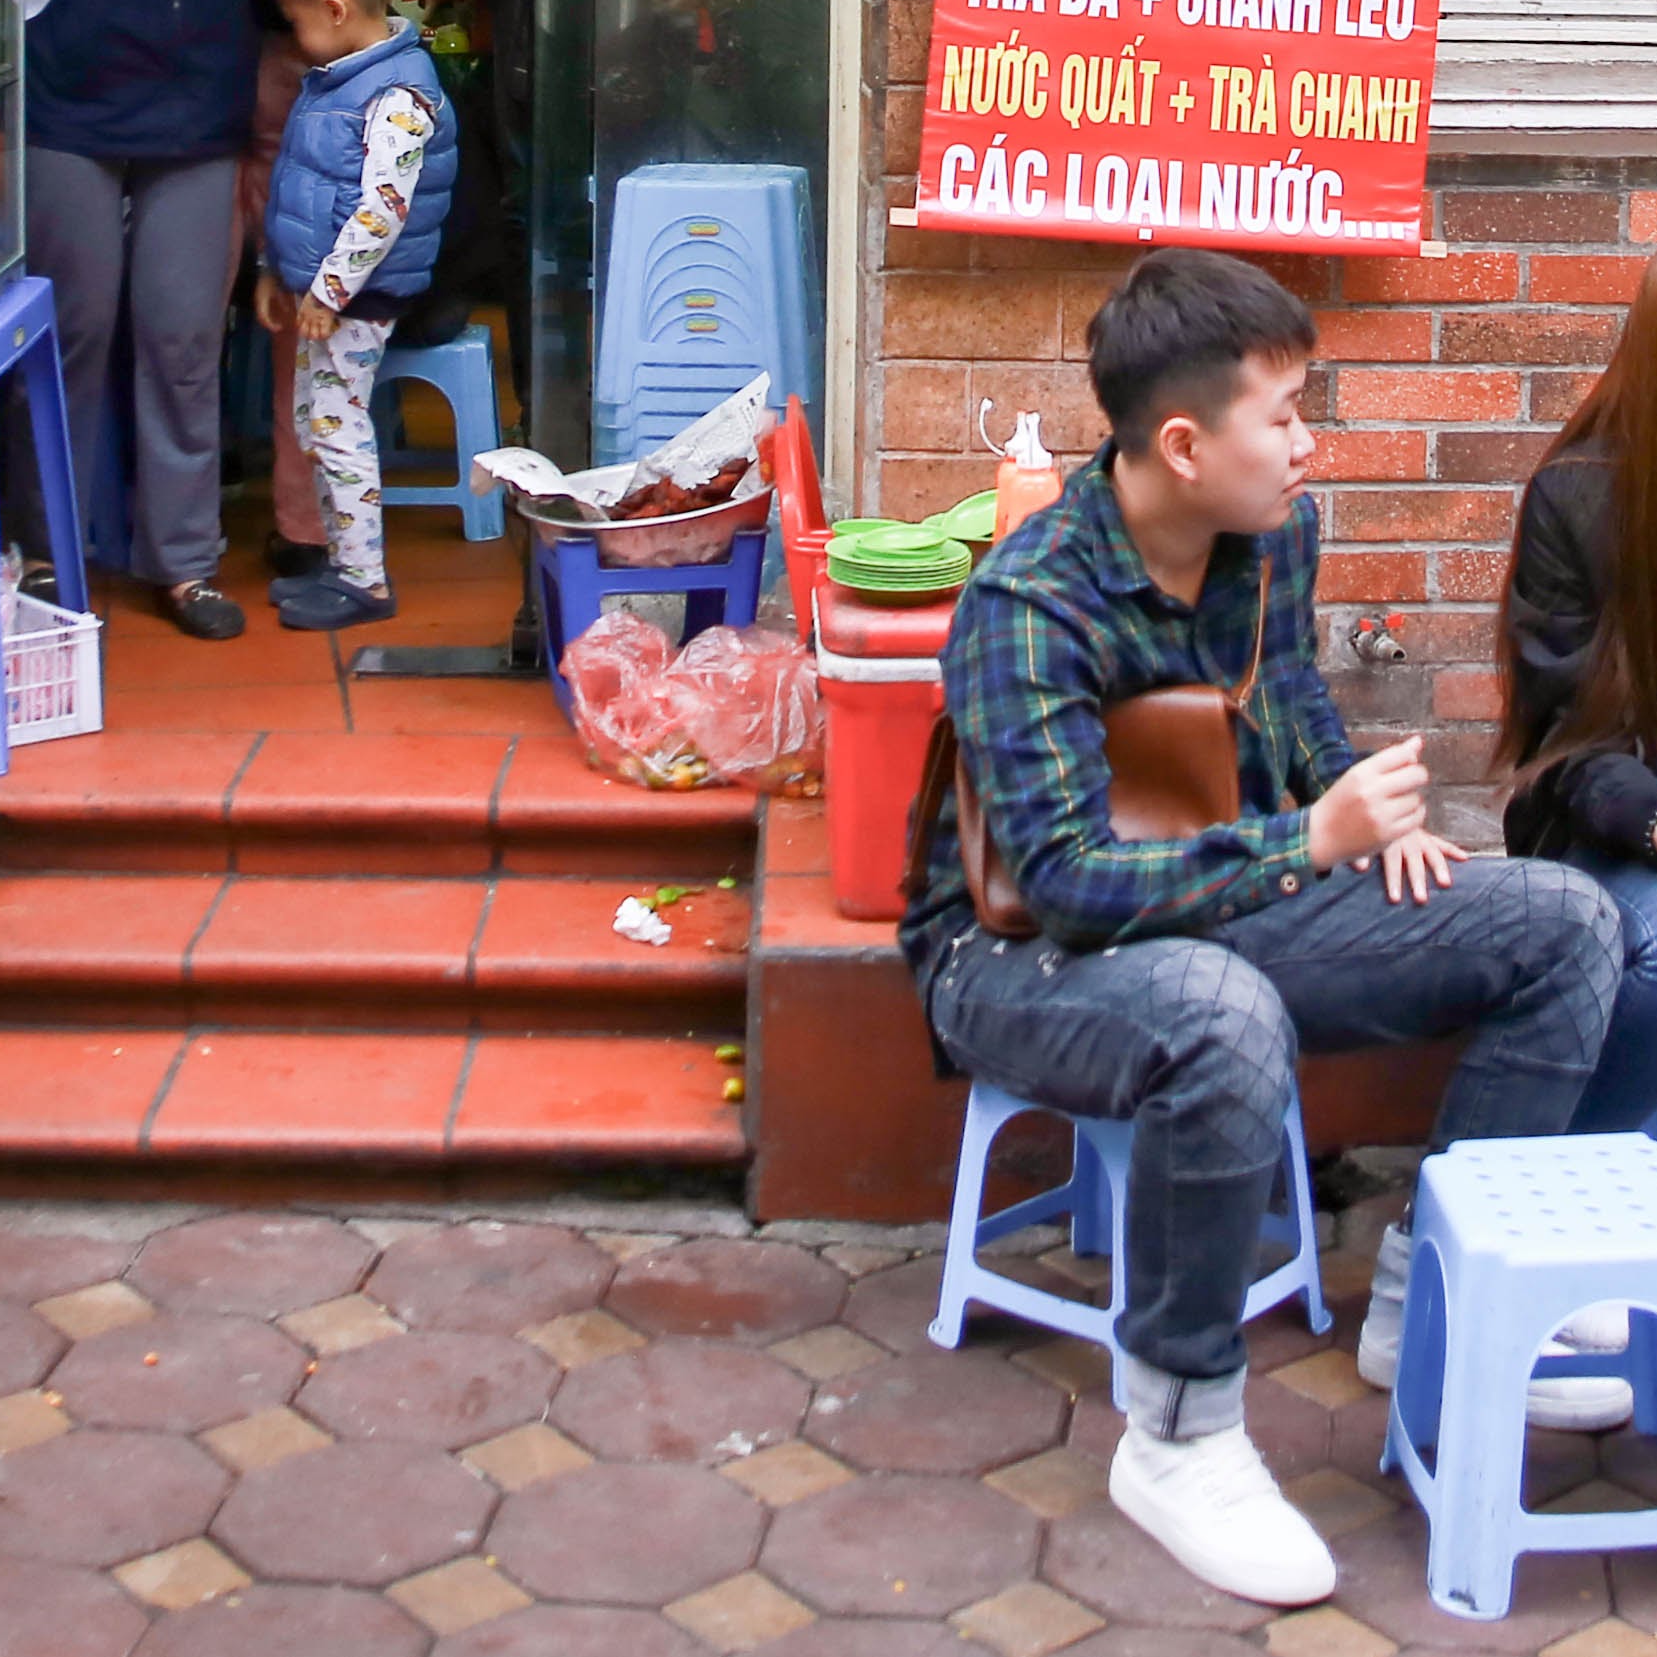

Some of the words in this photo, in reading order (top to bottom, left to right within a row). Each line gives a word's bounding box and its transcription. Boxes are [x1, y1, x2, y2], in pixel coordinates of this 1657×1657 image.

[940, 28, 1050, 120] NƯỚC
[1060, 35, 1161, 130] QUẤT
[1208, 53, 1278, 136] TRÀ
[1289, 70, 1421, 145] CHANH
[939, 132, 1049, 218] CÁC
[1063, 152, 1184, 241] LOẠI
